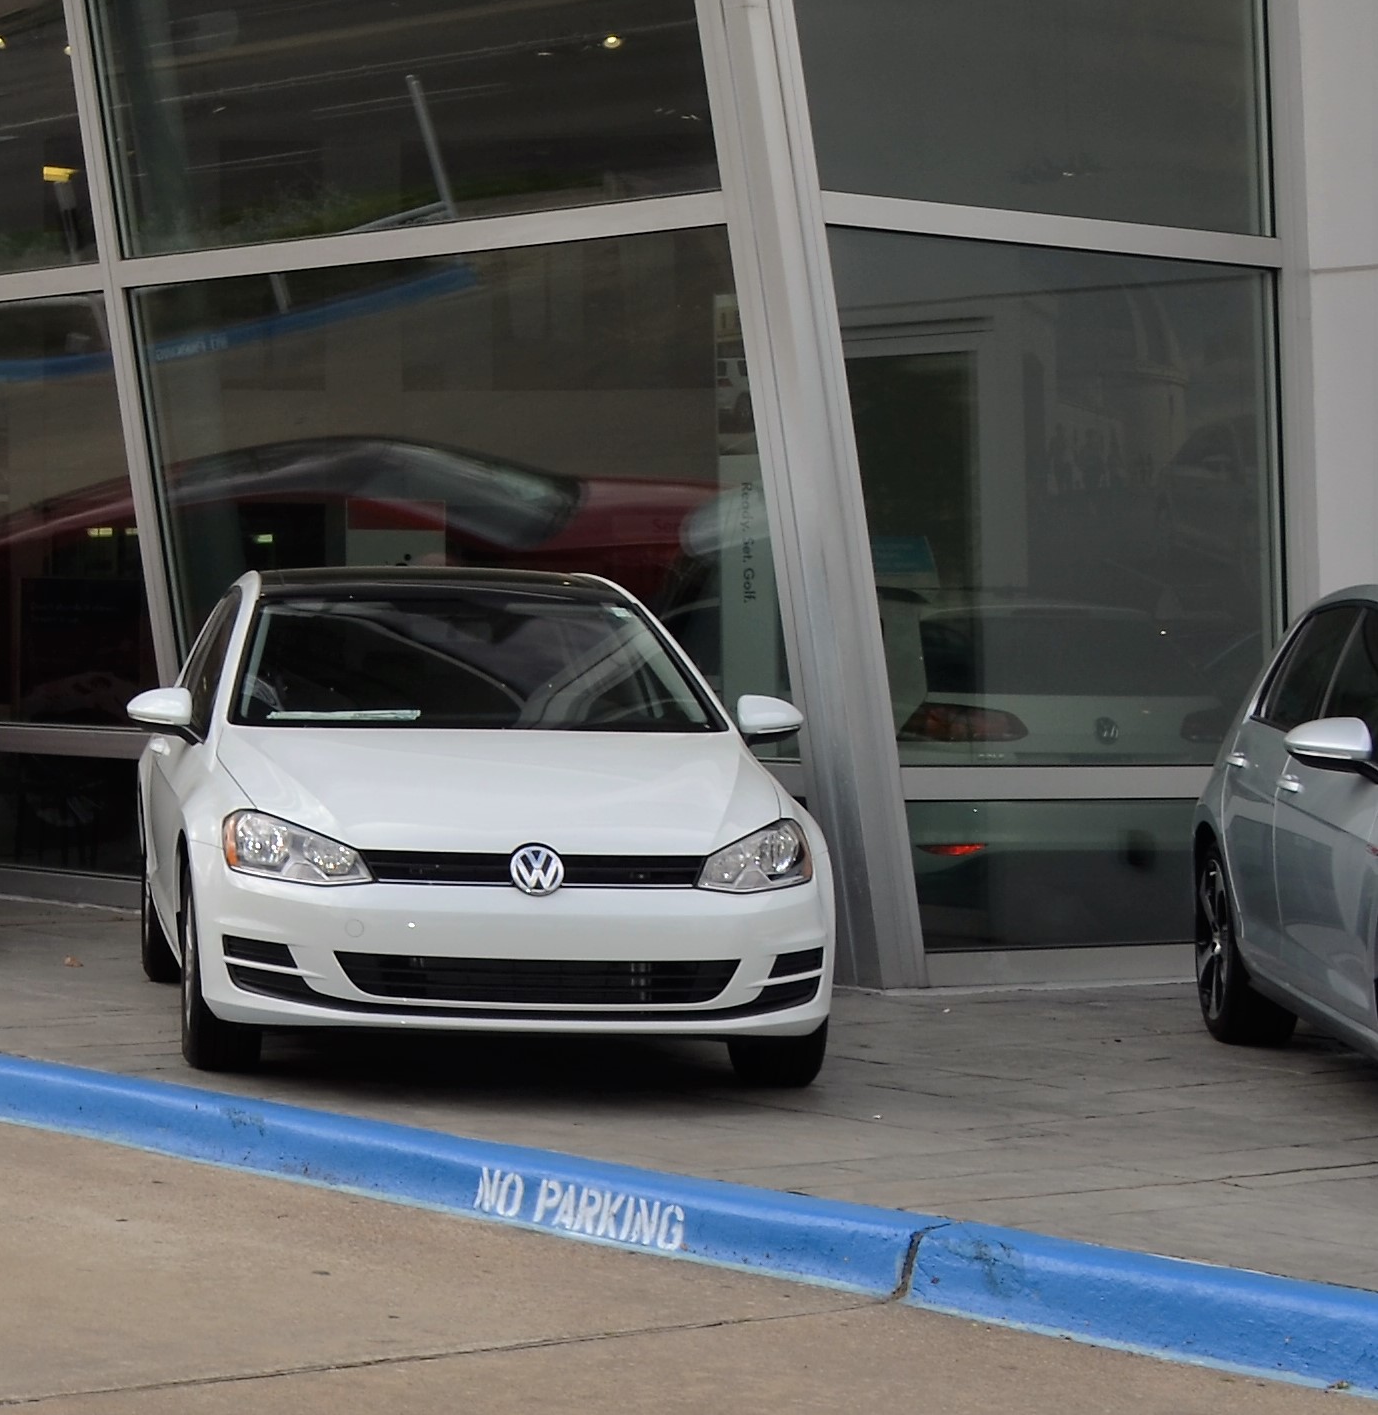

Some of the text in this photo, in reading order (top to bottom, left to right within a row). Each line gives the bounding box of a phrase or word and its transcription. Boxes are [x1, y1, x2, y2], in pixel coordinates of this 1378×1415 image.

[743, 568, 757, 603] Golf.
[511, 847, 564, 895] VW
[473, 1166, 685, 1252] NO PARKING
